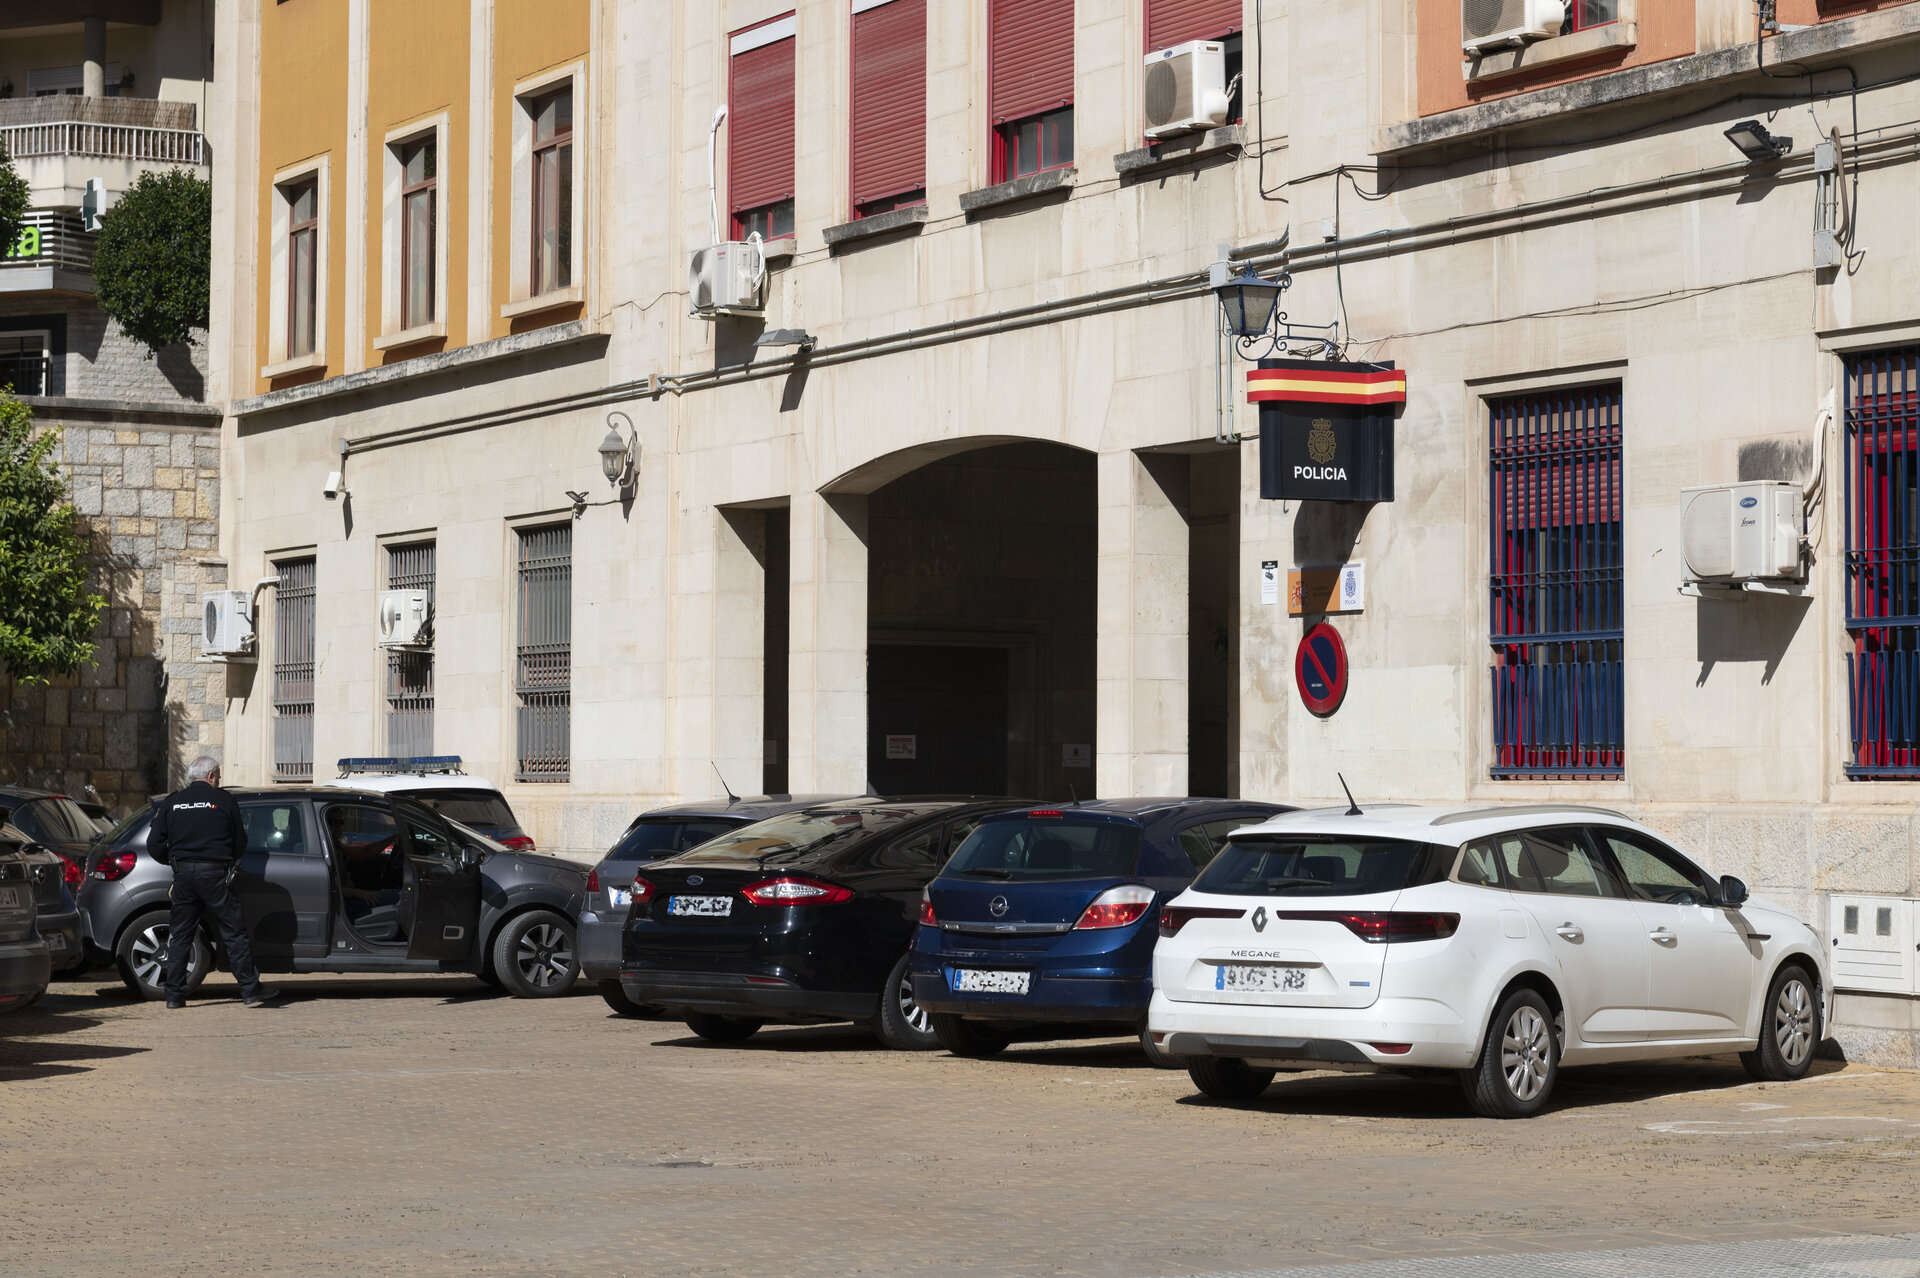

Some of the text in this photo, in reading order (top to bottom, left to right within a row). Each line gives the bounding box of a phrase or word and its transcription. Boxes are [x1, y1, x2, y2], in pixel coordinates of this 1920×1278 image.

[1294, 466, 1348, 480] POLICIA
[173, 802, 212, 810] POLICIA
[1231, 950, 1281, 958] MEGANE
